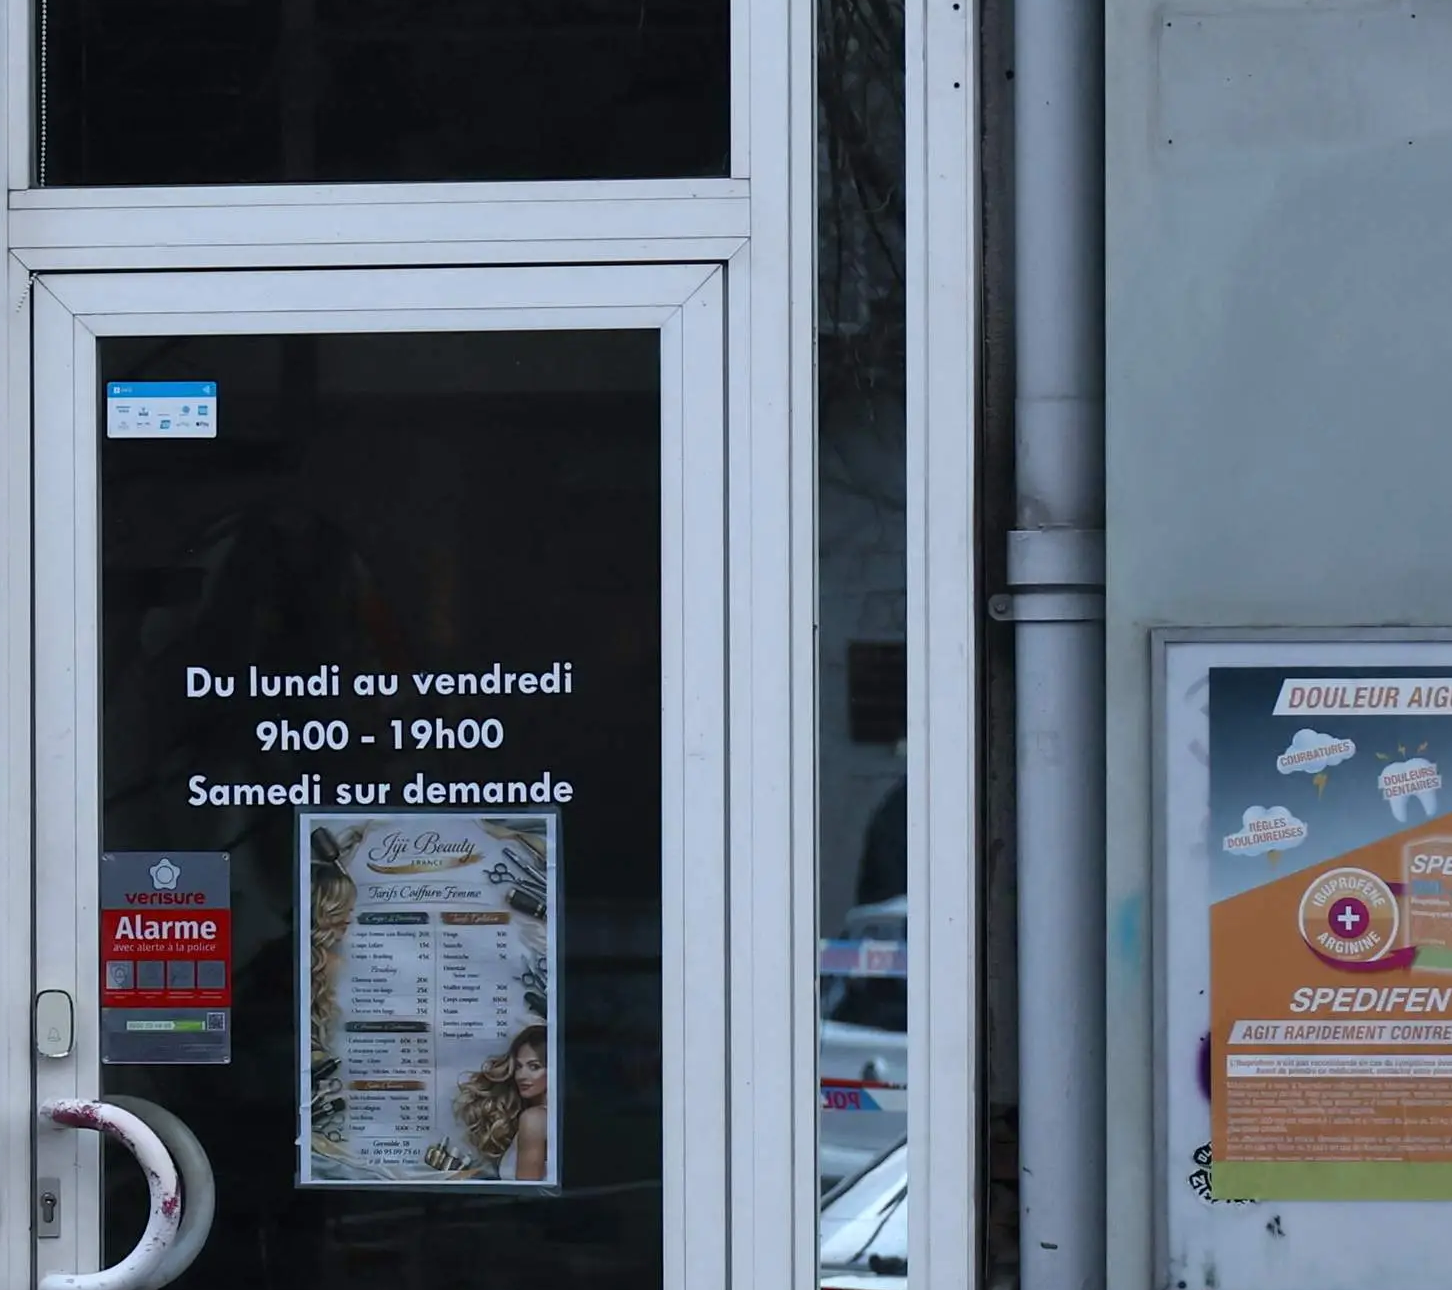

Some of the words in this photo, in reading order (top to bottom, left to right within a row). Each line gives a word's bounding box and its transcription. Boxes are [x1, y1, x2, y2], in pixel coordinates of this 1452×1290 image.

[186, 666, 235, 698] Du
[250, 664, 340, 697] lundi
[353, 672, 398, 696] au
[412, 662, 573, 695] vendredi
[1288, 685, 1400, 709] DOULEUR
[256, 719, 349, 751] 9h00
[360, 734, 375, 744] -
[390, 717, 504, 751] 19h00
[1279, 741, 1351, 767] COURBATURES
[188, 773, 321, 806] Samedi
[336, 781, 391, 806] sur
[403, 771, 575, 805] demande
[1383, 765, 1437, 786] DOULEURS
[1384, 777, 1441, 799] DENTAIRES
[414, 830, 477, 863] Beauty
[1227, 826, 1304, 849] DOULOUREUSES
[124, 892, 207, 905] verisure
[1312, 875, 1387, 908] IBUPROFÈNE
[114, 914, 218, 941] Alarme
[112, 944, 134, 952] avec
[137, 943, 165, 952] alerte
[168, 943, 173, 952] à
[176, 943, 184, 952] la
[187, 942, 216, 953] police
[1316, 930, 1382, 956] ARGININE
[1289, 987, 1452, 1013] SPEDIFEN
[1241, 1025, 1281, 1040] AGIT
[1283, 1025, 1387, 1041] RAPIDEMENT
[1390, 1025, 1452, 1041] CONTRE
